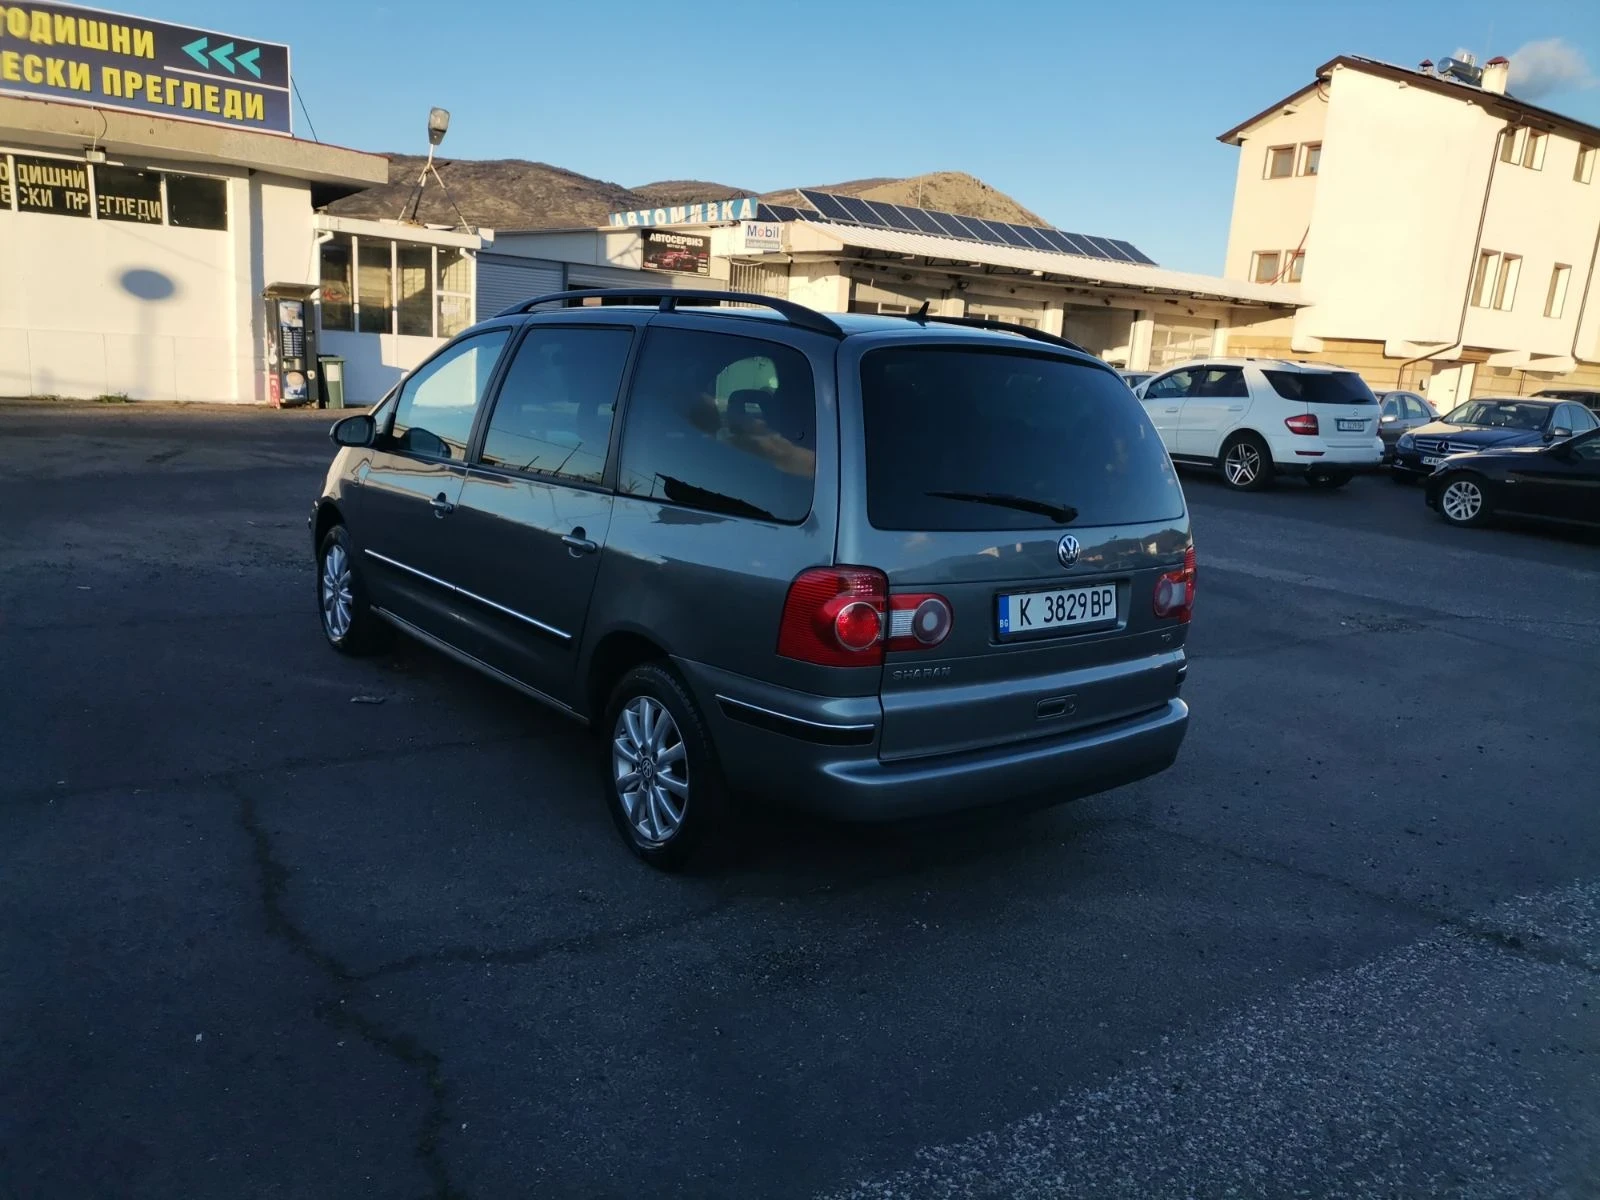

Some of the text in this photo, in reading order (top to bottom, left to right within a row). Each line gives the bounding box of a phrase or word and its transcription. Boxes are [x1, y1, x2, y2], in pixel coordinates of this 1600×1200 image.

[103, 66, 264, 121] ПРЕГЛЕДИ
[614, 199, 752, 227] АВТОМИВКА
[747, 224, 779, 238] Mobil
[649, 232, 704, 247] АВТОСЕРВИЗ
[1020, 589, 1113, 626] K 3829 BP
[1000, 619, 1009, 628] BG
[892, 666, 951, 680] SHARAN
